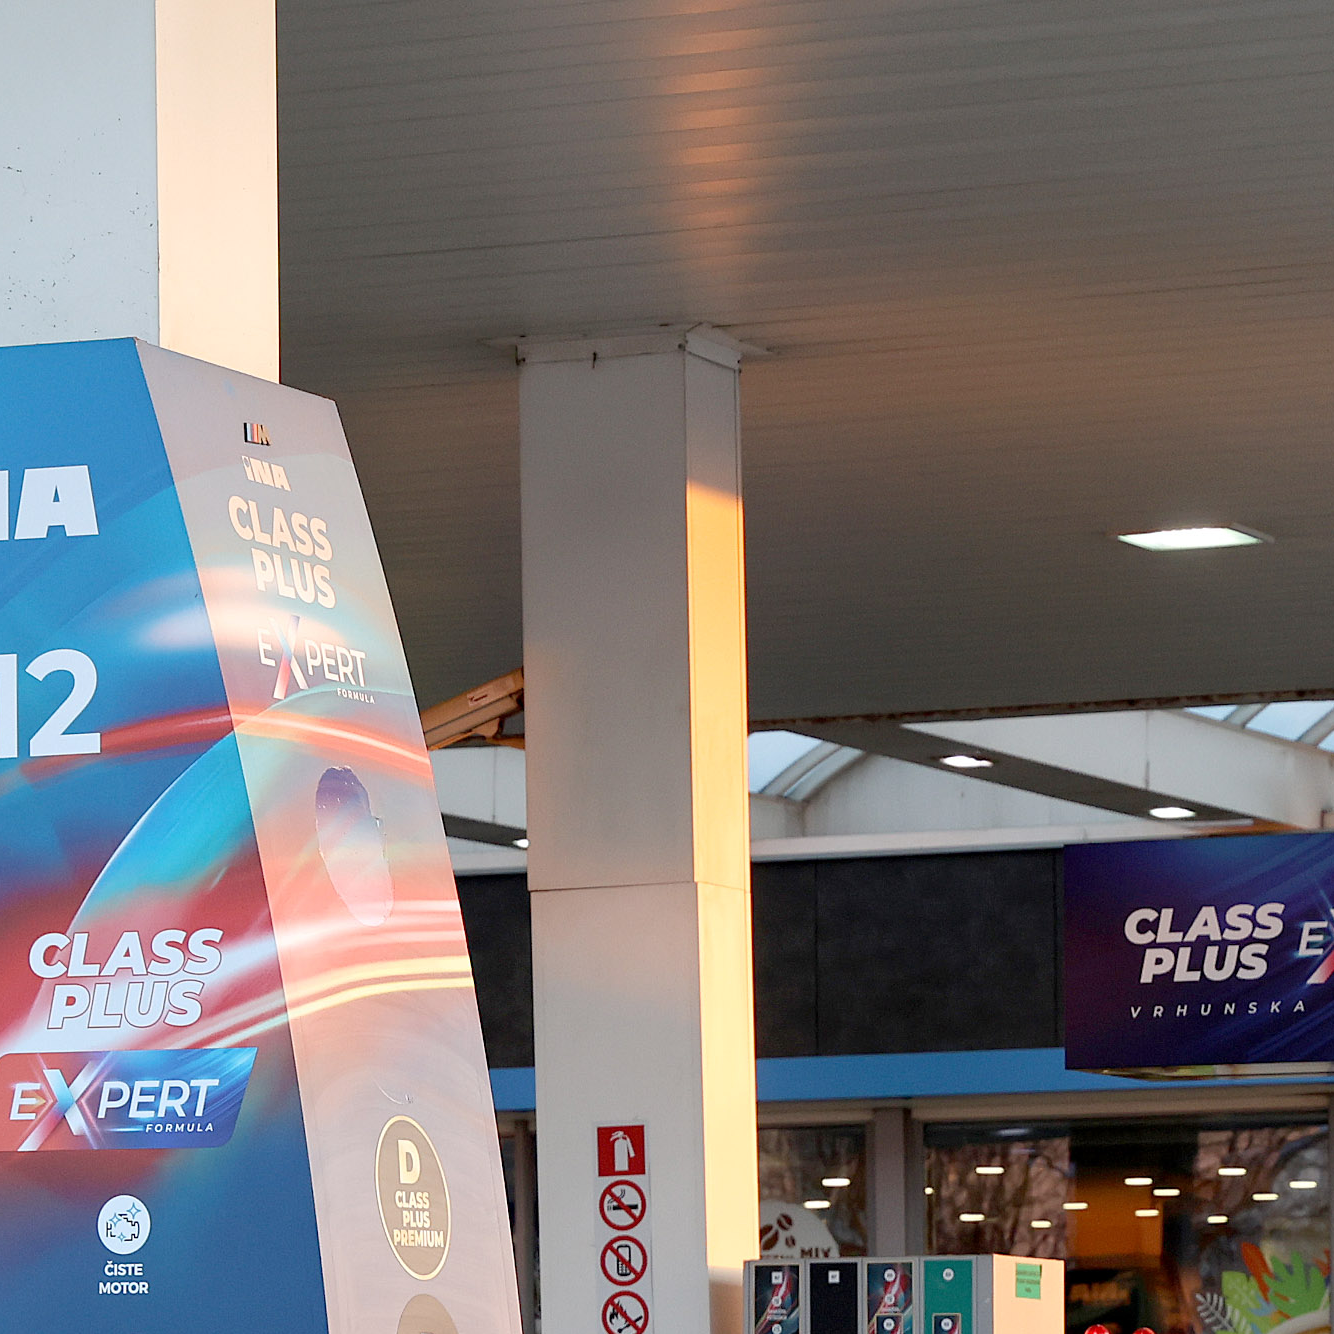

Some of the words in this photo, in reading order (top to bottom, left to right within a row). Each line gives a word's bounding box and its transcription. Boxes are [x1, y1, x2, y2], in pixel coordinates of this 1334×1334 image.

[228, 495, 333, 561] CLASS
[251, 548, 336, 608] PLUS
[257, 615, 366, 700] EXPERT
[1124, 902, 1286, 944] CLASS
[29, 928, 223, 979] CLASS
[1139, 942, 1270, 984] PLUS
[46, 980, 204, 1030] PLUS
[1130, 999, 1305, 1019] VRHUNSKA
[145, 1122, 215, 1134] FORMULA
[397, 1139, 421, 1184] D
[395, 1190, 430, 1210] CLASS
[402, 1211, 431, 1228] PLUS
[393, 1229, 444, 1248] PREMIUM
[98, 1282, 149, 1294] MOTOR
[104, 1260, 143, 1276] ČISTE
